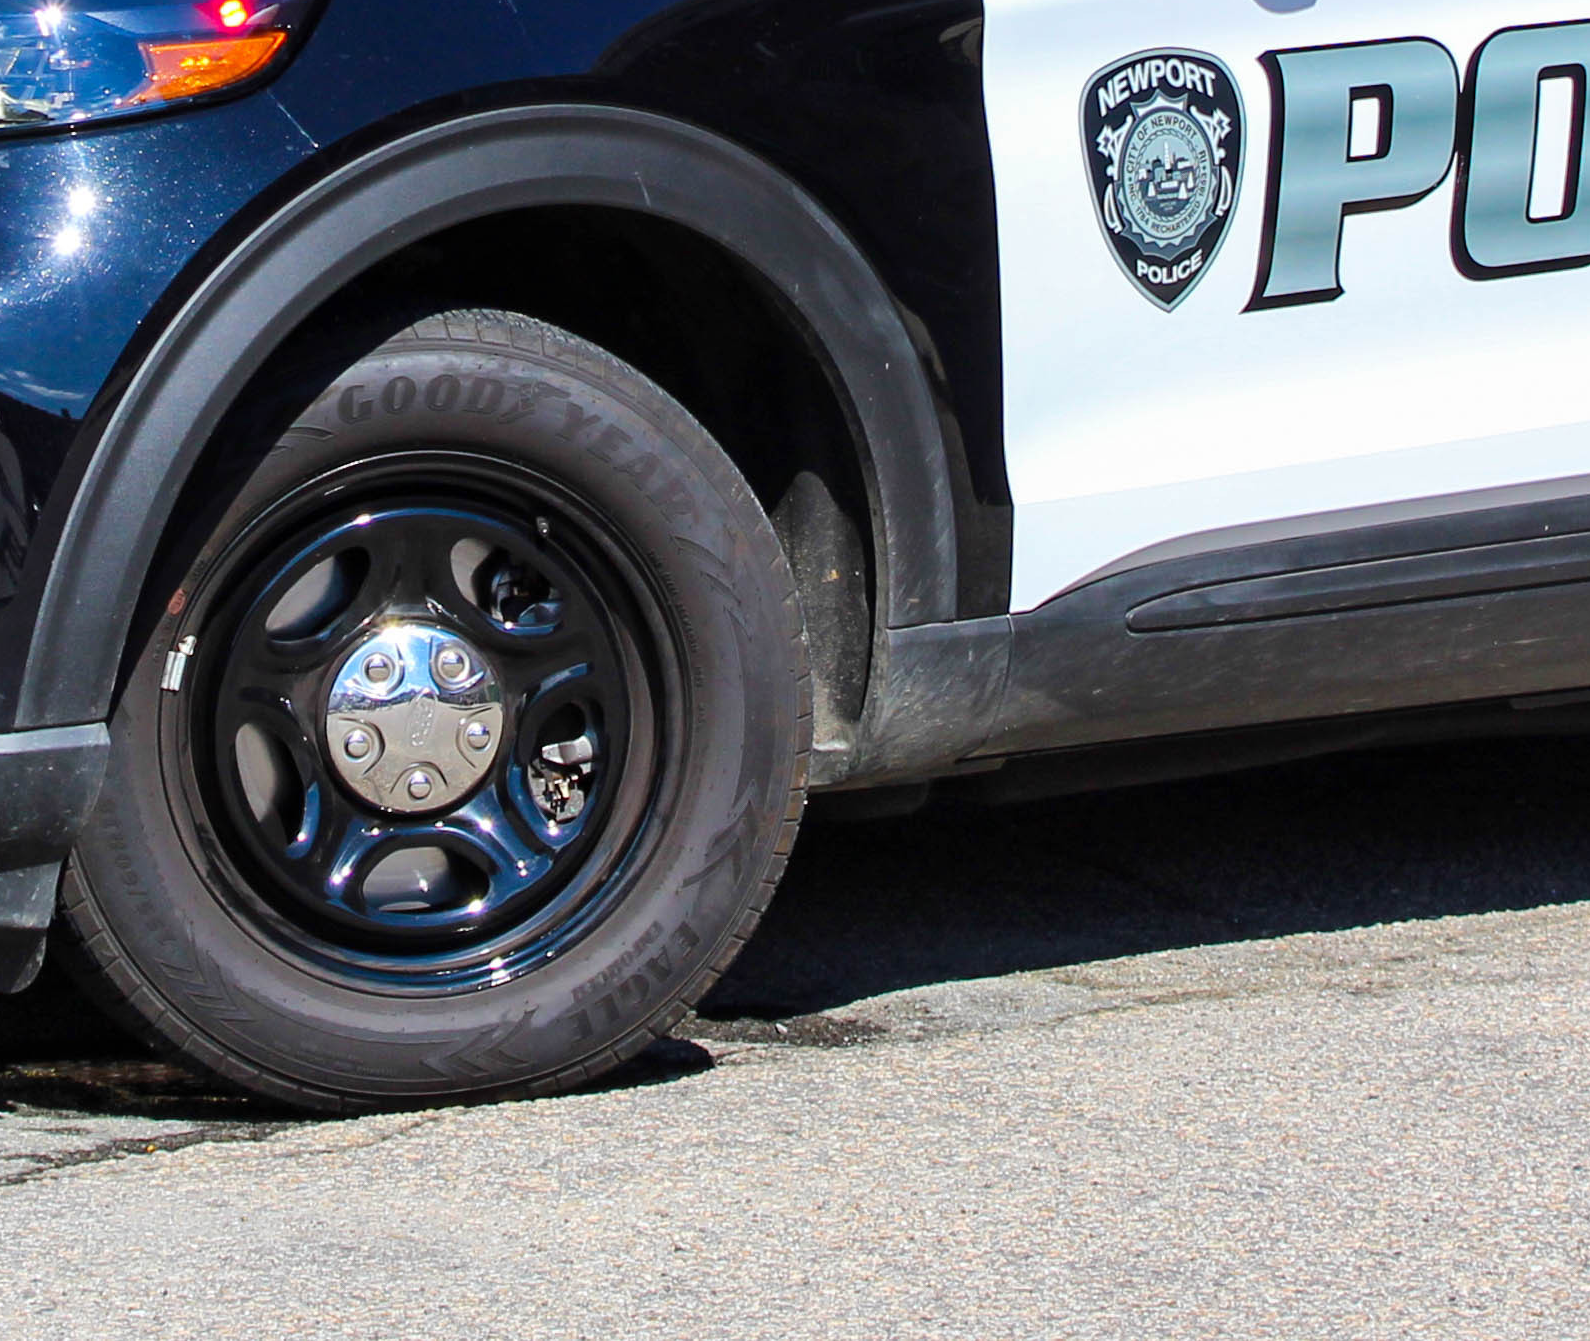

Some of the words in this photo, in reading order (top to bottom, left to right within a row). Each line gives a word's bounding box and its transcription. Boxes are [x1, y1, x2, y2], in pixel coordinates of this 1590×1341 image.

[1097, 58, 1216, 117] NEWPORT
[1125, 144, 1139, 174] CITY
[1137, 123, 1149, 141] OF
[1198, 149, 1208, 163] RI
[1136, 248, 1204, 285] POLICE
[337, 373, 704, 525] GOODYEAR
[568, 918, 701, 1043] EAGLE
